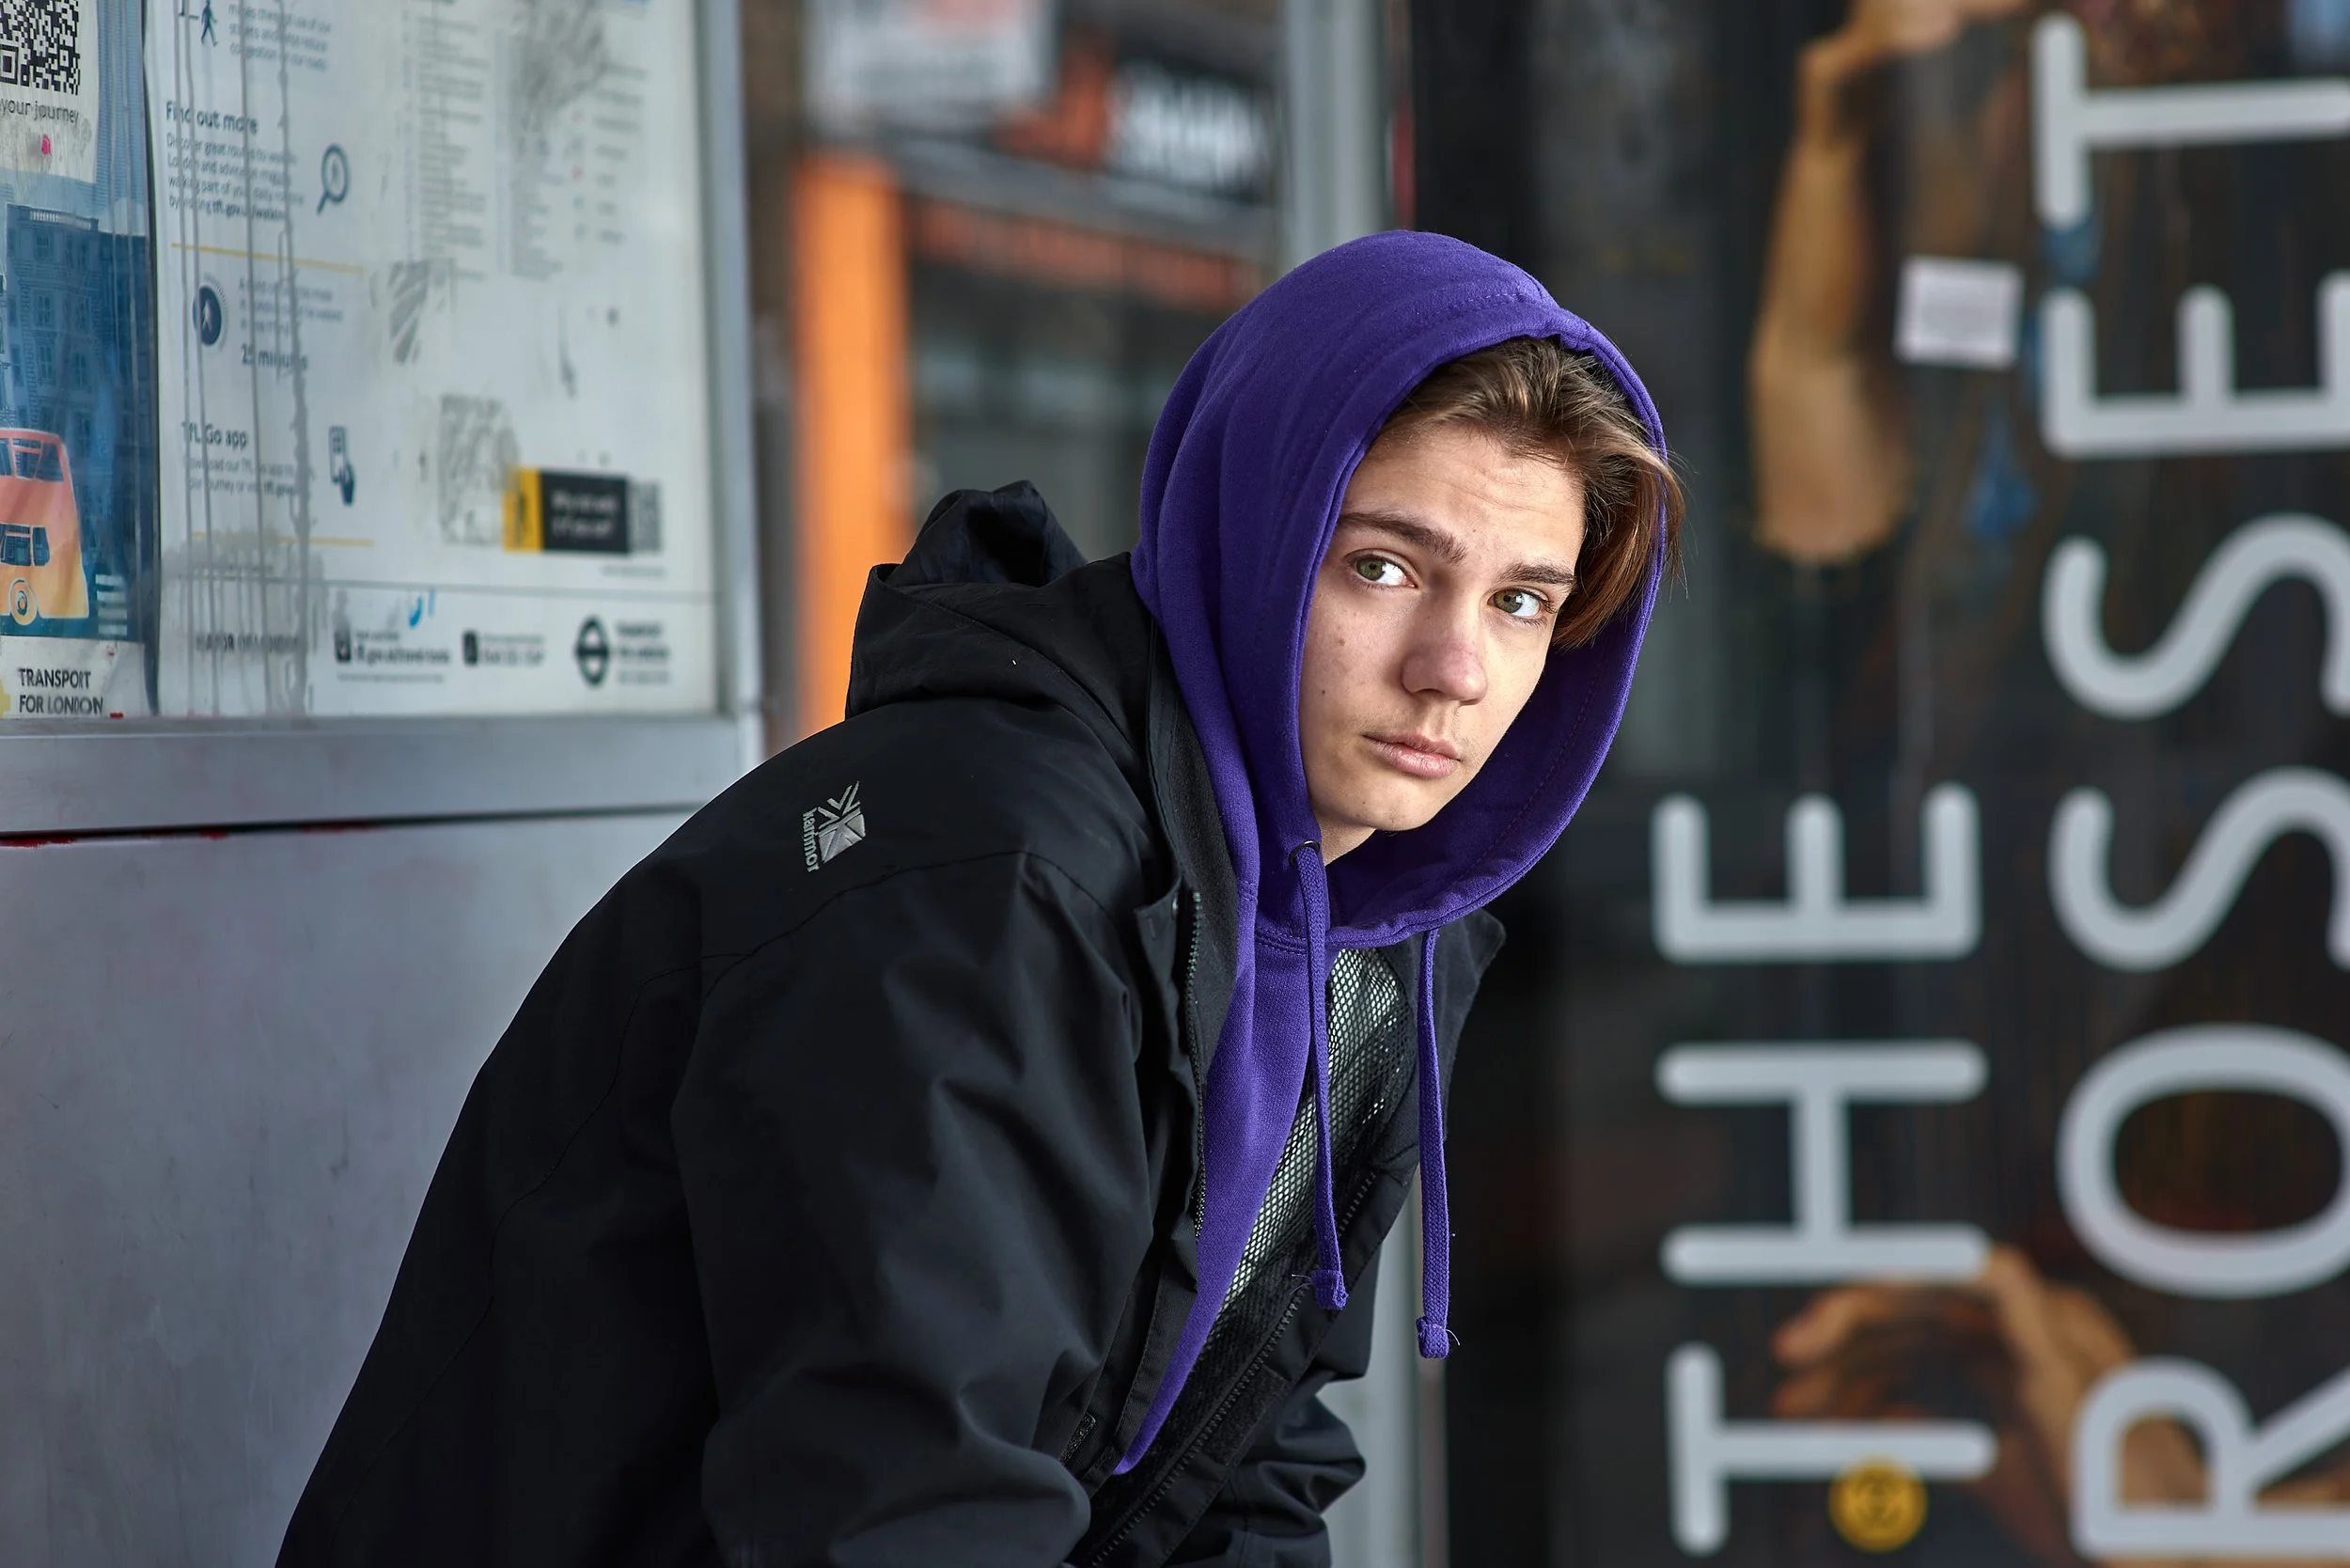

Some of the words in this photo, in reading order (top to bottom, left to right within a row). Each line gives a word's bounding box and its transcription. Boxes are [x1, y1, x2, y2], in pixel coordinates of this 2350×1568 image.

[1, 99, 31, 117] your
[34, 100, 79, 128] journey
[196, 110, 220, 130] out
[258, 350, 308, 371] minus
[226, 430, 247, 451] app
[19, 695, 44, 713] FOR
[47, 696, 103, 714] LONDON
[803, 807, 820, 872] karrimor
[1652, 780, 1998, 1553] THE
